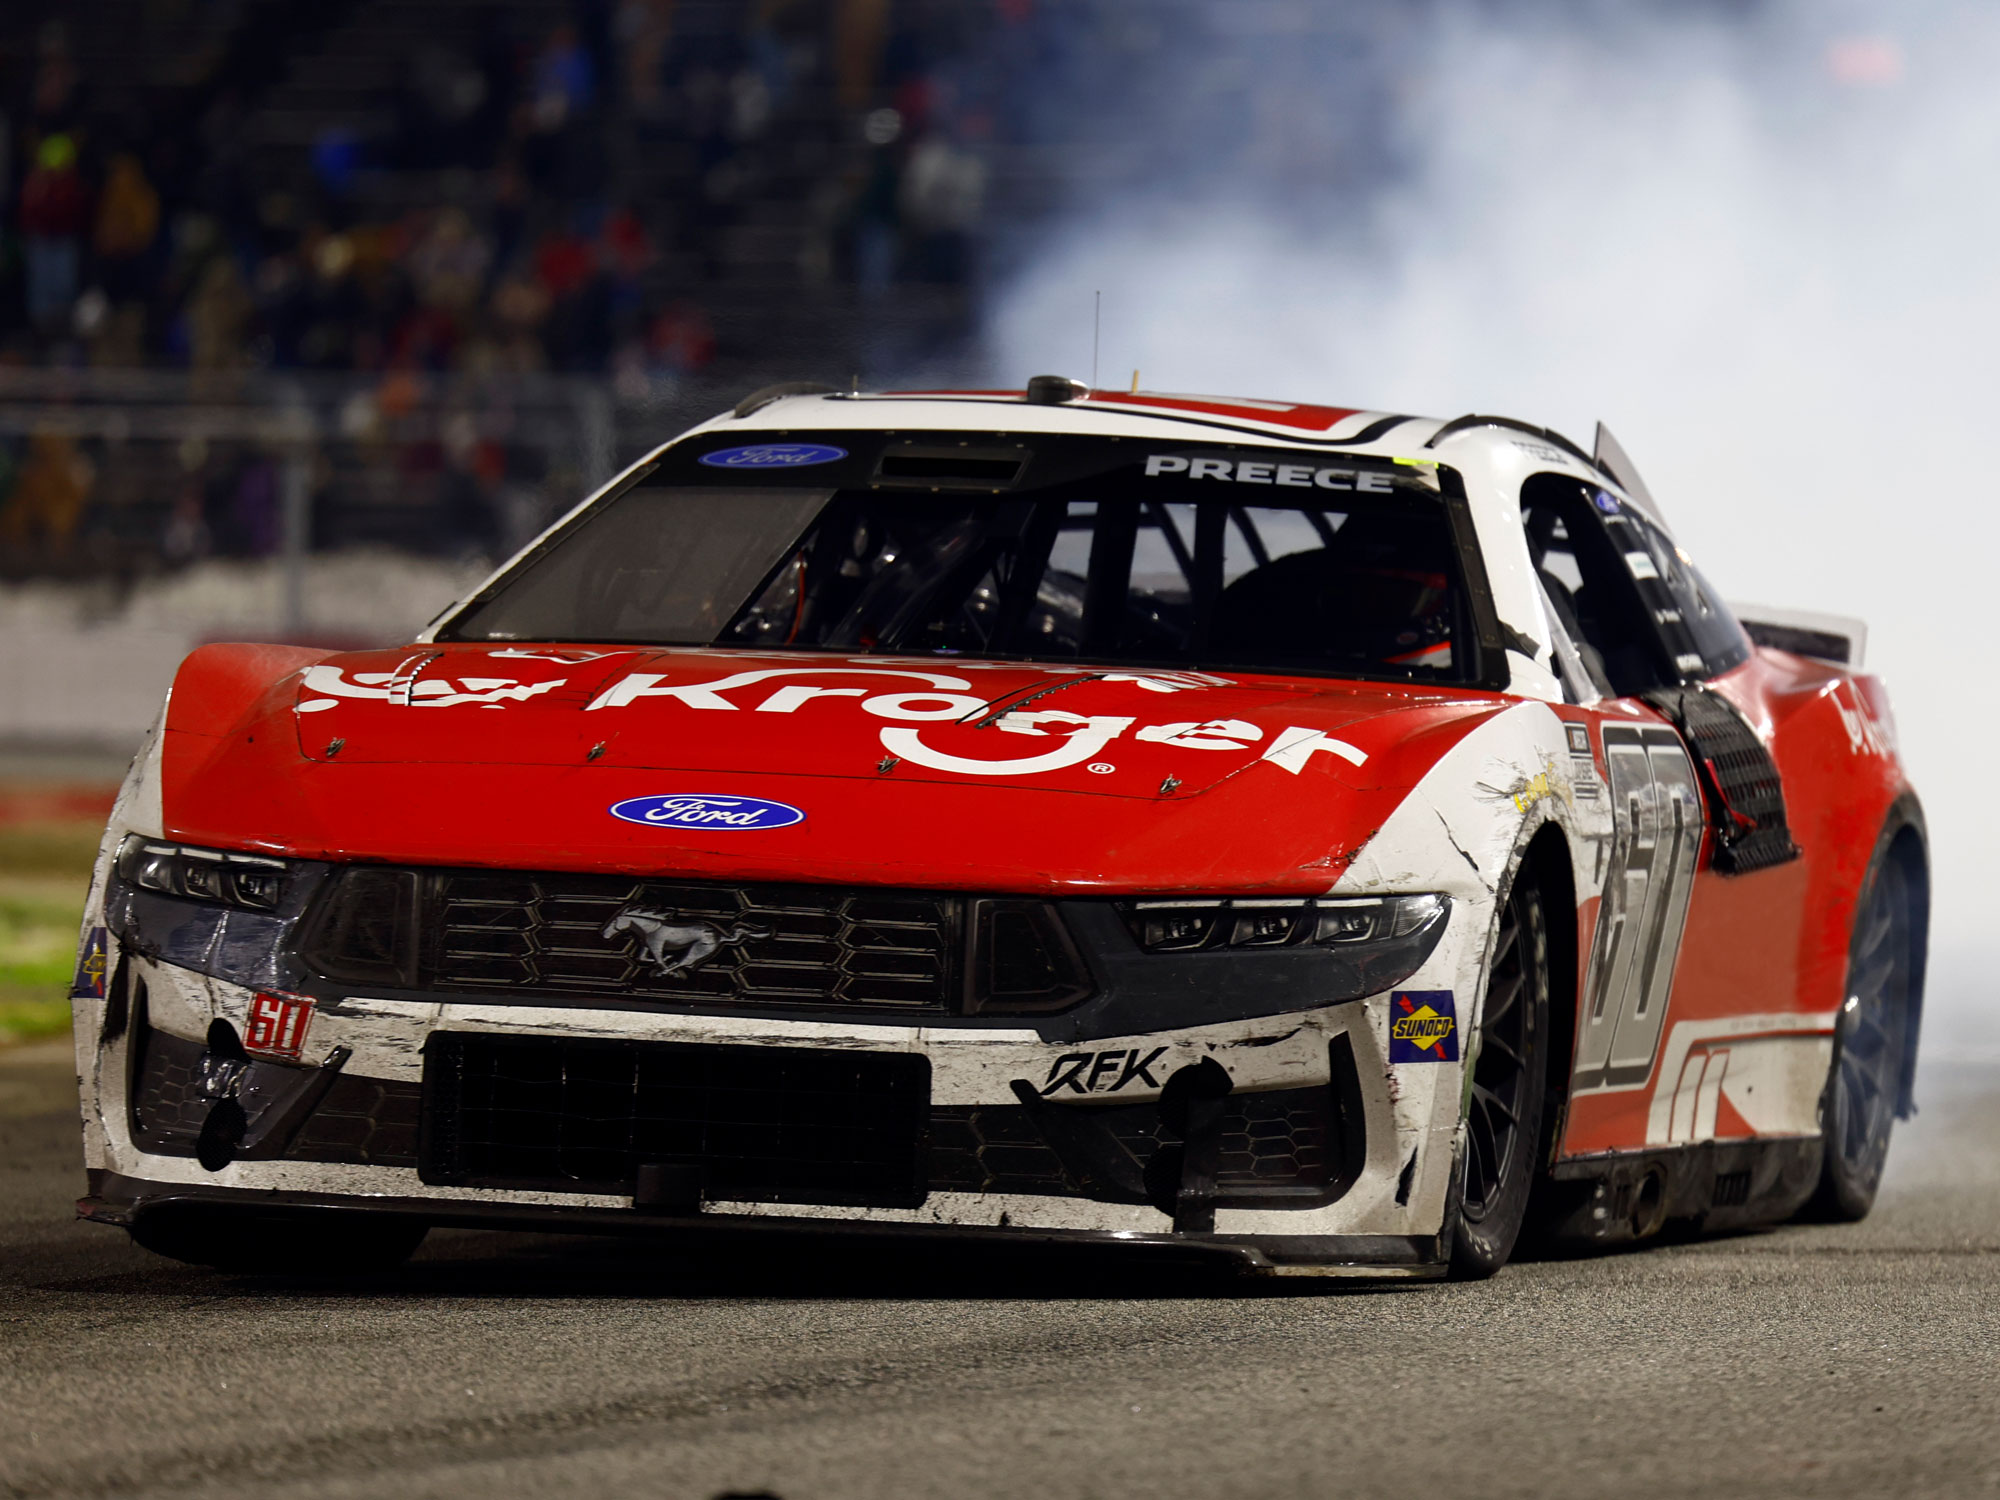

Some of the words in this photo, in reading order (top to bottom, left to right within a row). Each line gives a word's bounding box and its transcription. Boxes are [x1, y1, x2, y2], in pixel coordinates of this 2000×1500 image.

[726, 448, 820, 464] Ford
[1145, 455, 1393, 493] PREECE
[585, 668, 1369, 776] Kroger
[645, 797, 768, 826] Ford
[1572, 727, 1702, 1088] 60
[245, 991, 313, 1055] 60
[1394, 1018, 1451, 1038] SUNOCO
[1041, 1046, 1170, 1096] RFK
